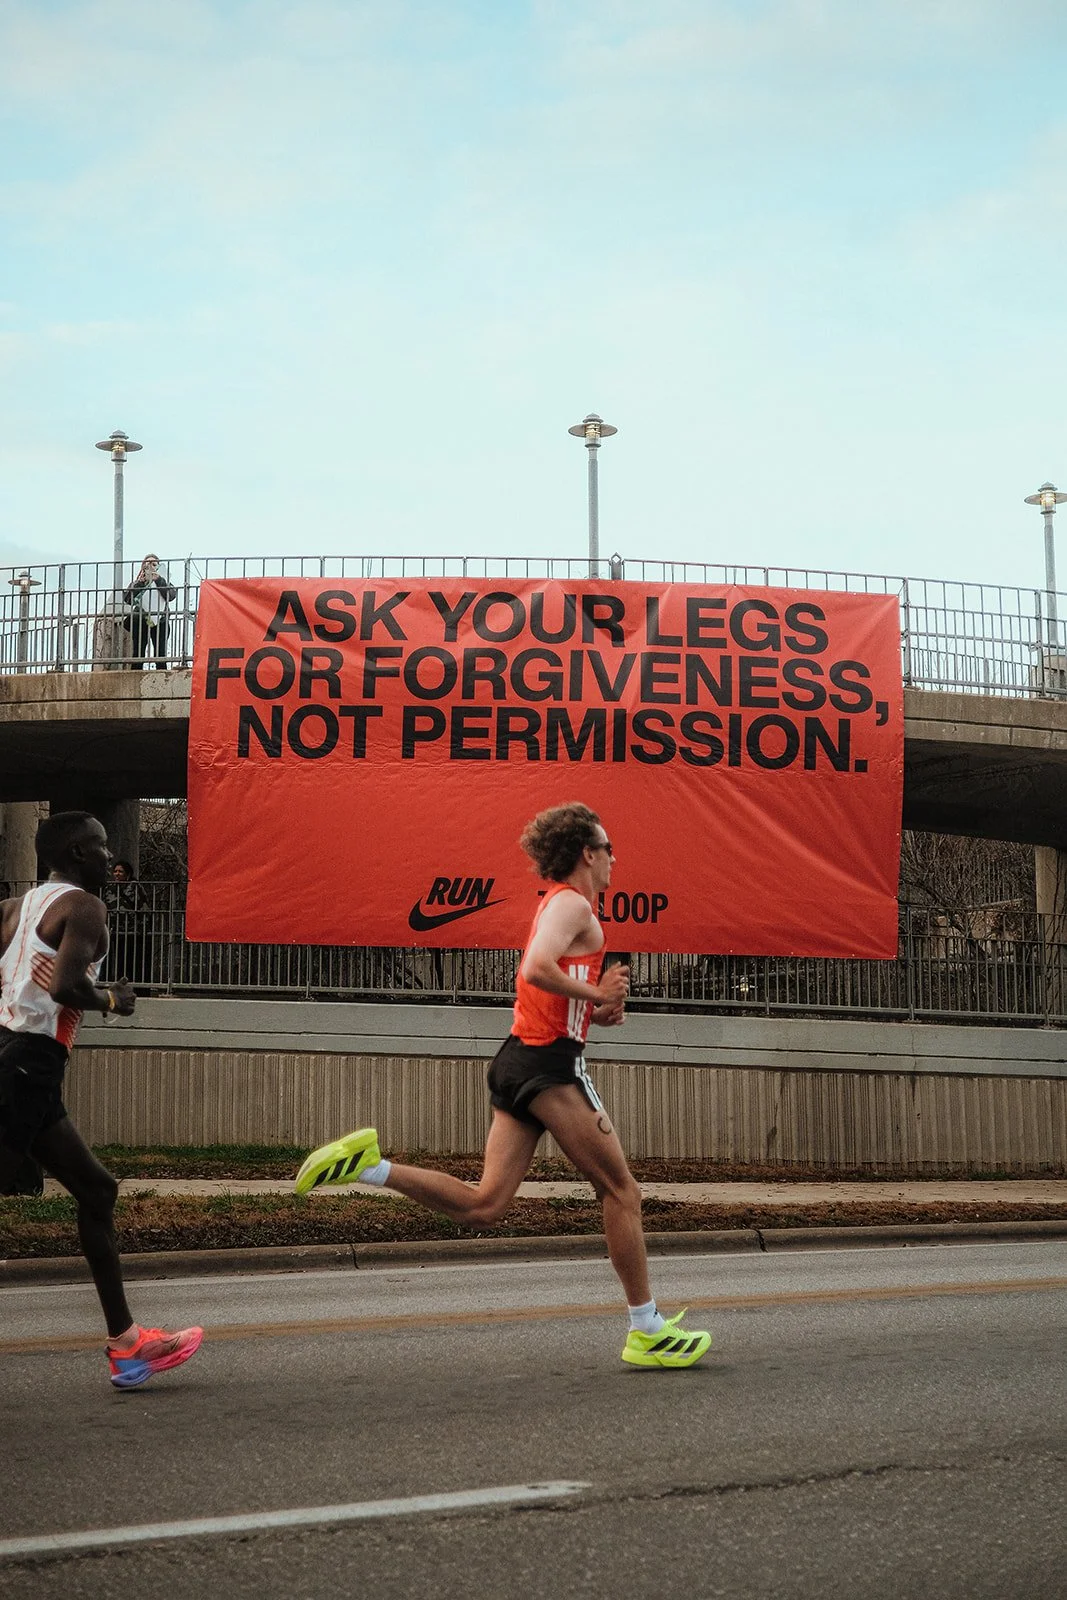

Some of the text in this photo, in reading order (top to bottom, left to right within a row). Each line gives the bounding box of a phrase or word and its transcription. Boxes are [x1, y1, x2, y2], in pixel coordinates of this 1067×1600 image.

[262, 590, 829, 655] ASK YOUR LEGS
[205, 646, 889, 726] FOR FORGIVENESS,
[237, 704, 868, 773] NOT PERMISSION.
[425, 877, 495, 906] RUN
[598, 891, 669, 924] LOOP
